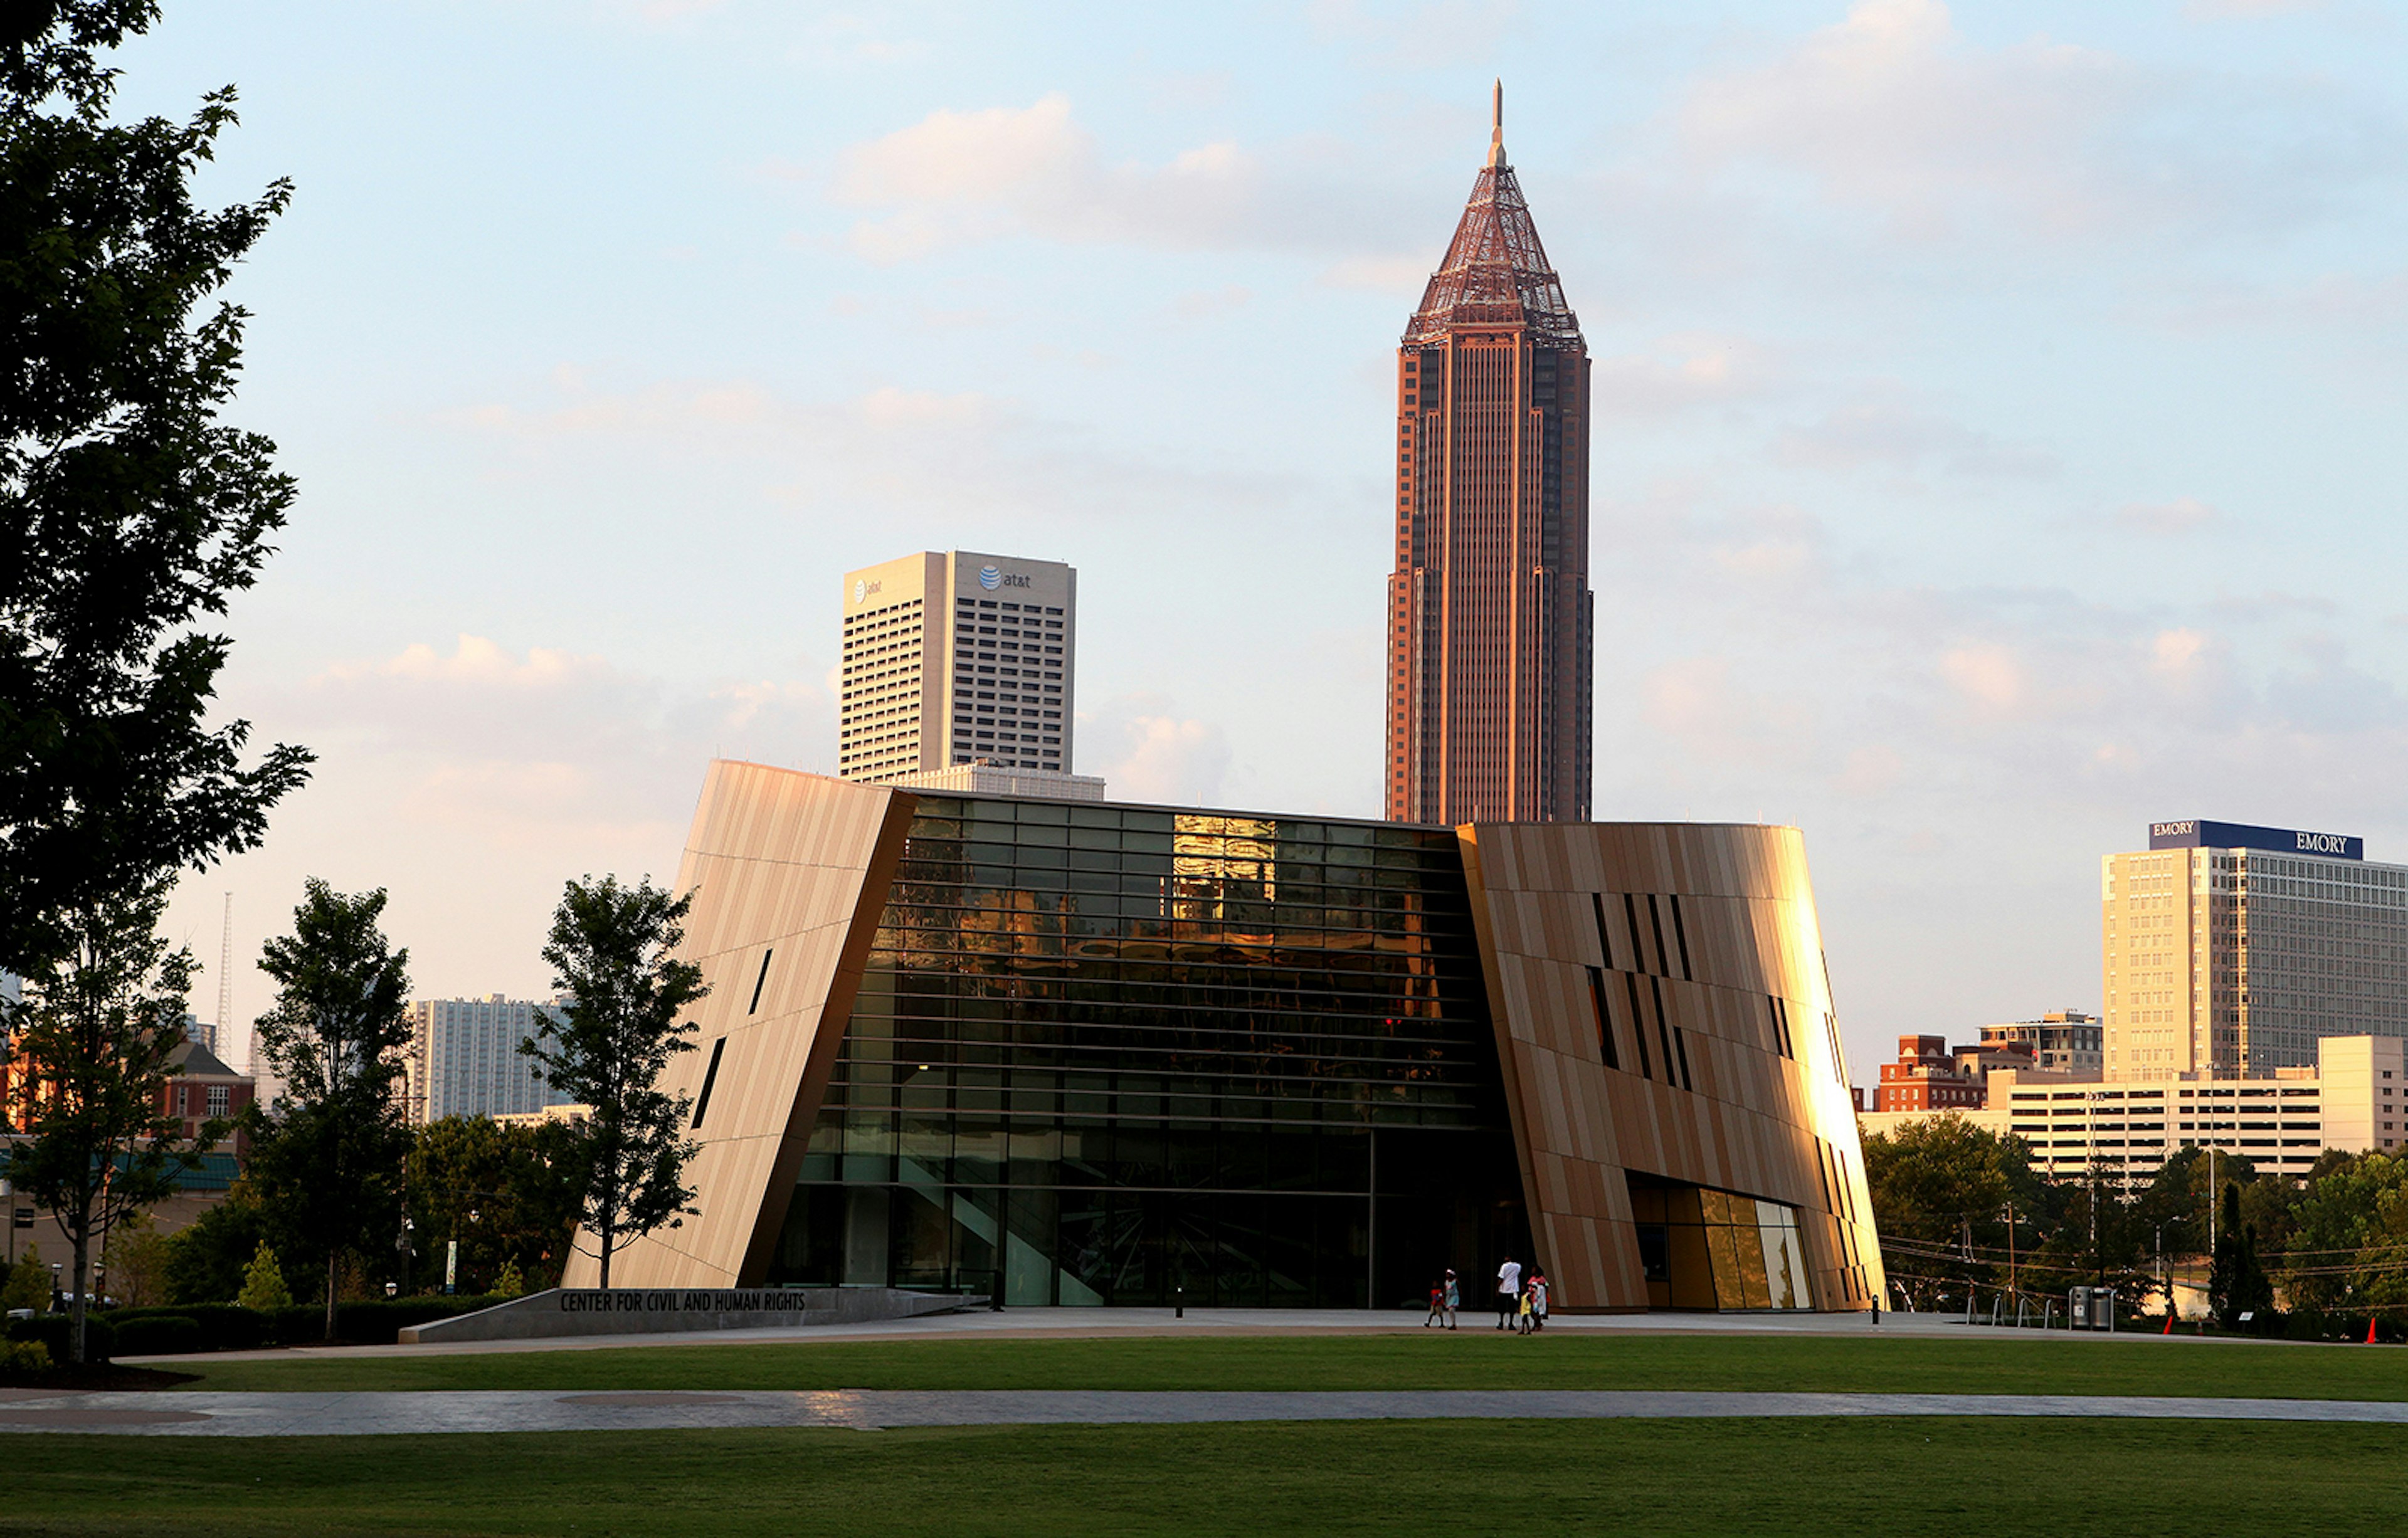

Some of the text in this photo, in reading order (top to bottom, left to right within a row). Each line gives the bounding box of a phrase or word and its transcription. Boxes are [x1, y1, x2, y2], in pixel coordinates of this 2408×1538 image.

[1004, 574, 1030, 588] at&t
[2154, 821, 2194, 836] EMORY
[2296, 832, 2347, 854] EMORY
[561, 1293, 805, 1311] CENTER FOR CIVIL AND HUMAN RIGHTS
